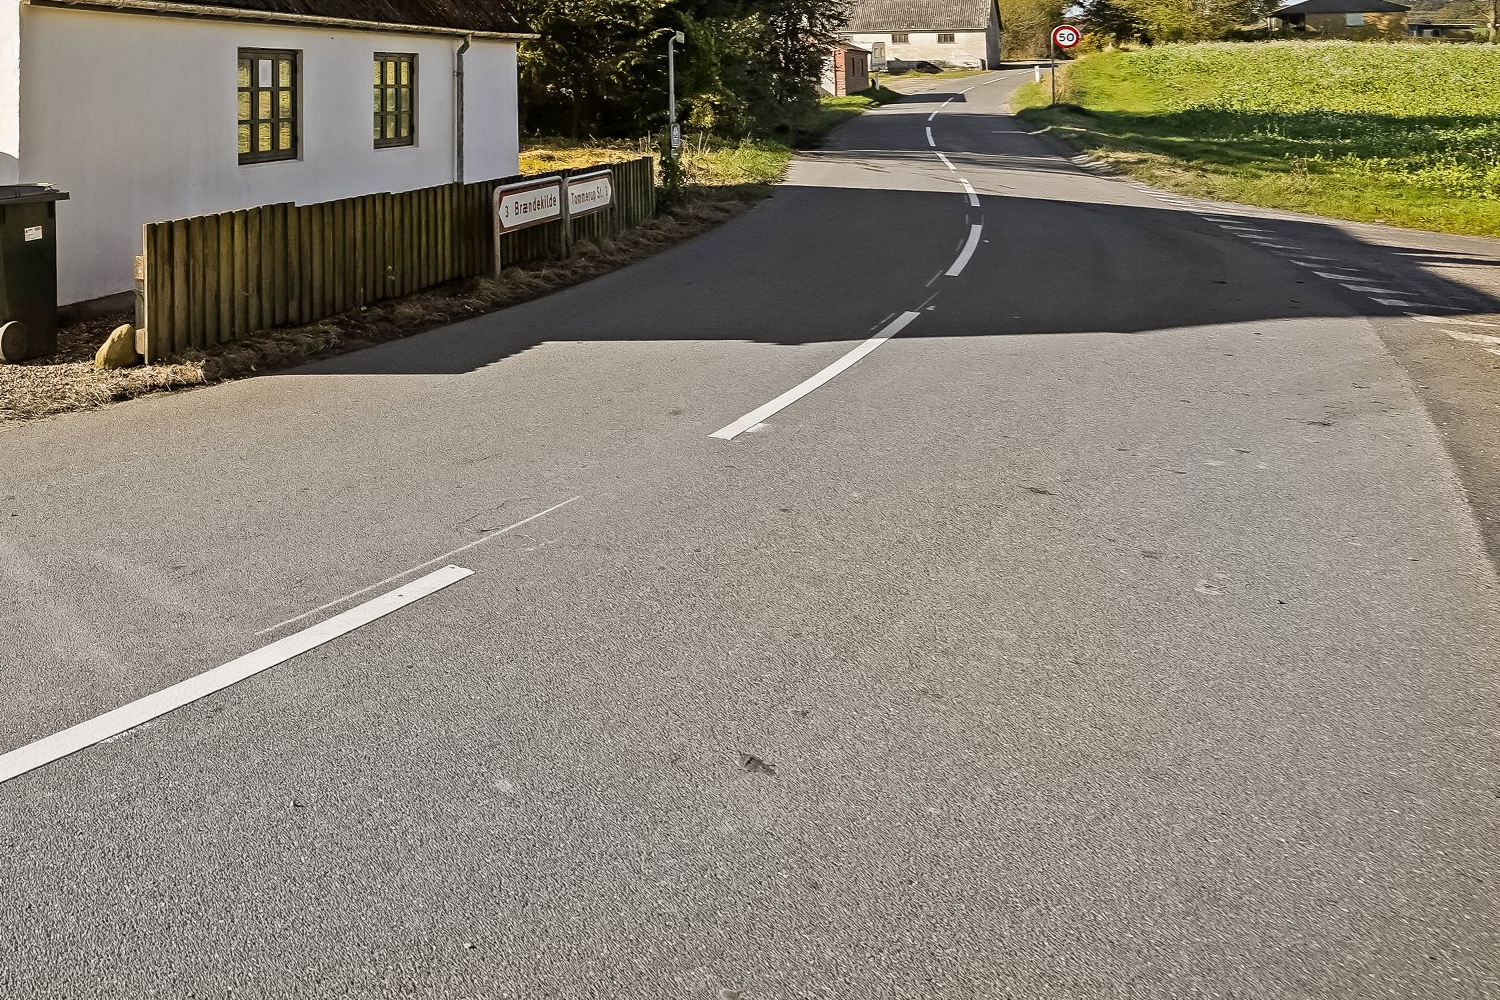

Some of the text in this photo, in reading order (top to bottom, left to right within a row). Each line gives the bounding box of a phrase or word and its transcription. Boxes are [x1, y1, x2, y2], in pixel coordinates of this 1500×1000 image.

[1058, 33, 1075, 42] 50
[570, 190, 596, 205] Tommerup
[504, 193, 557, 218] 3 Brændekilde
